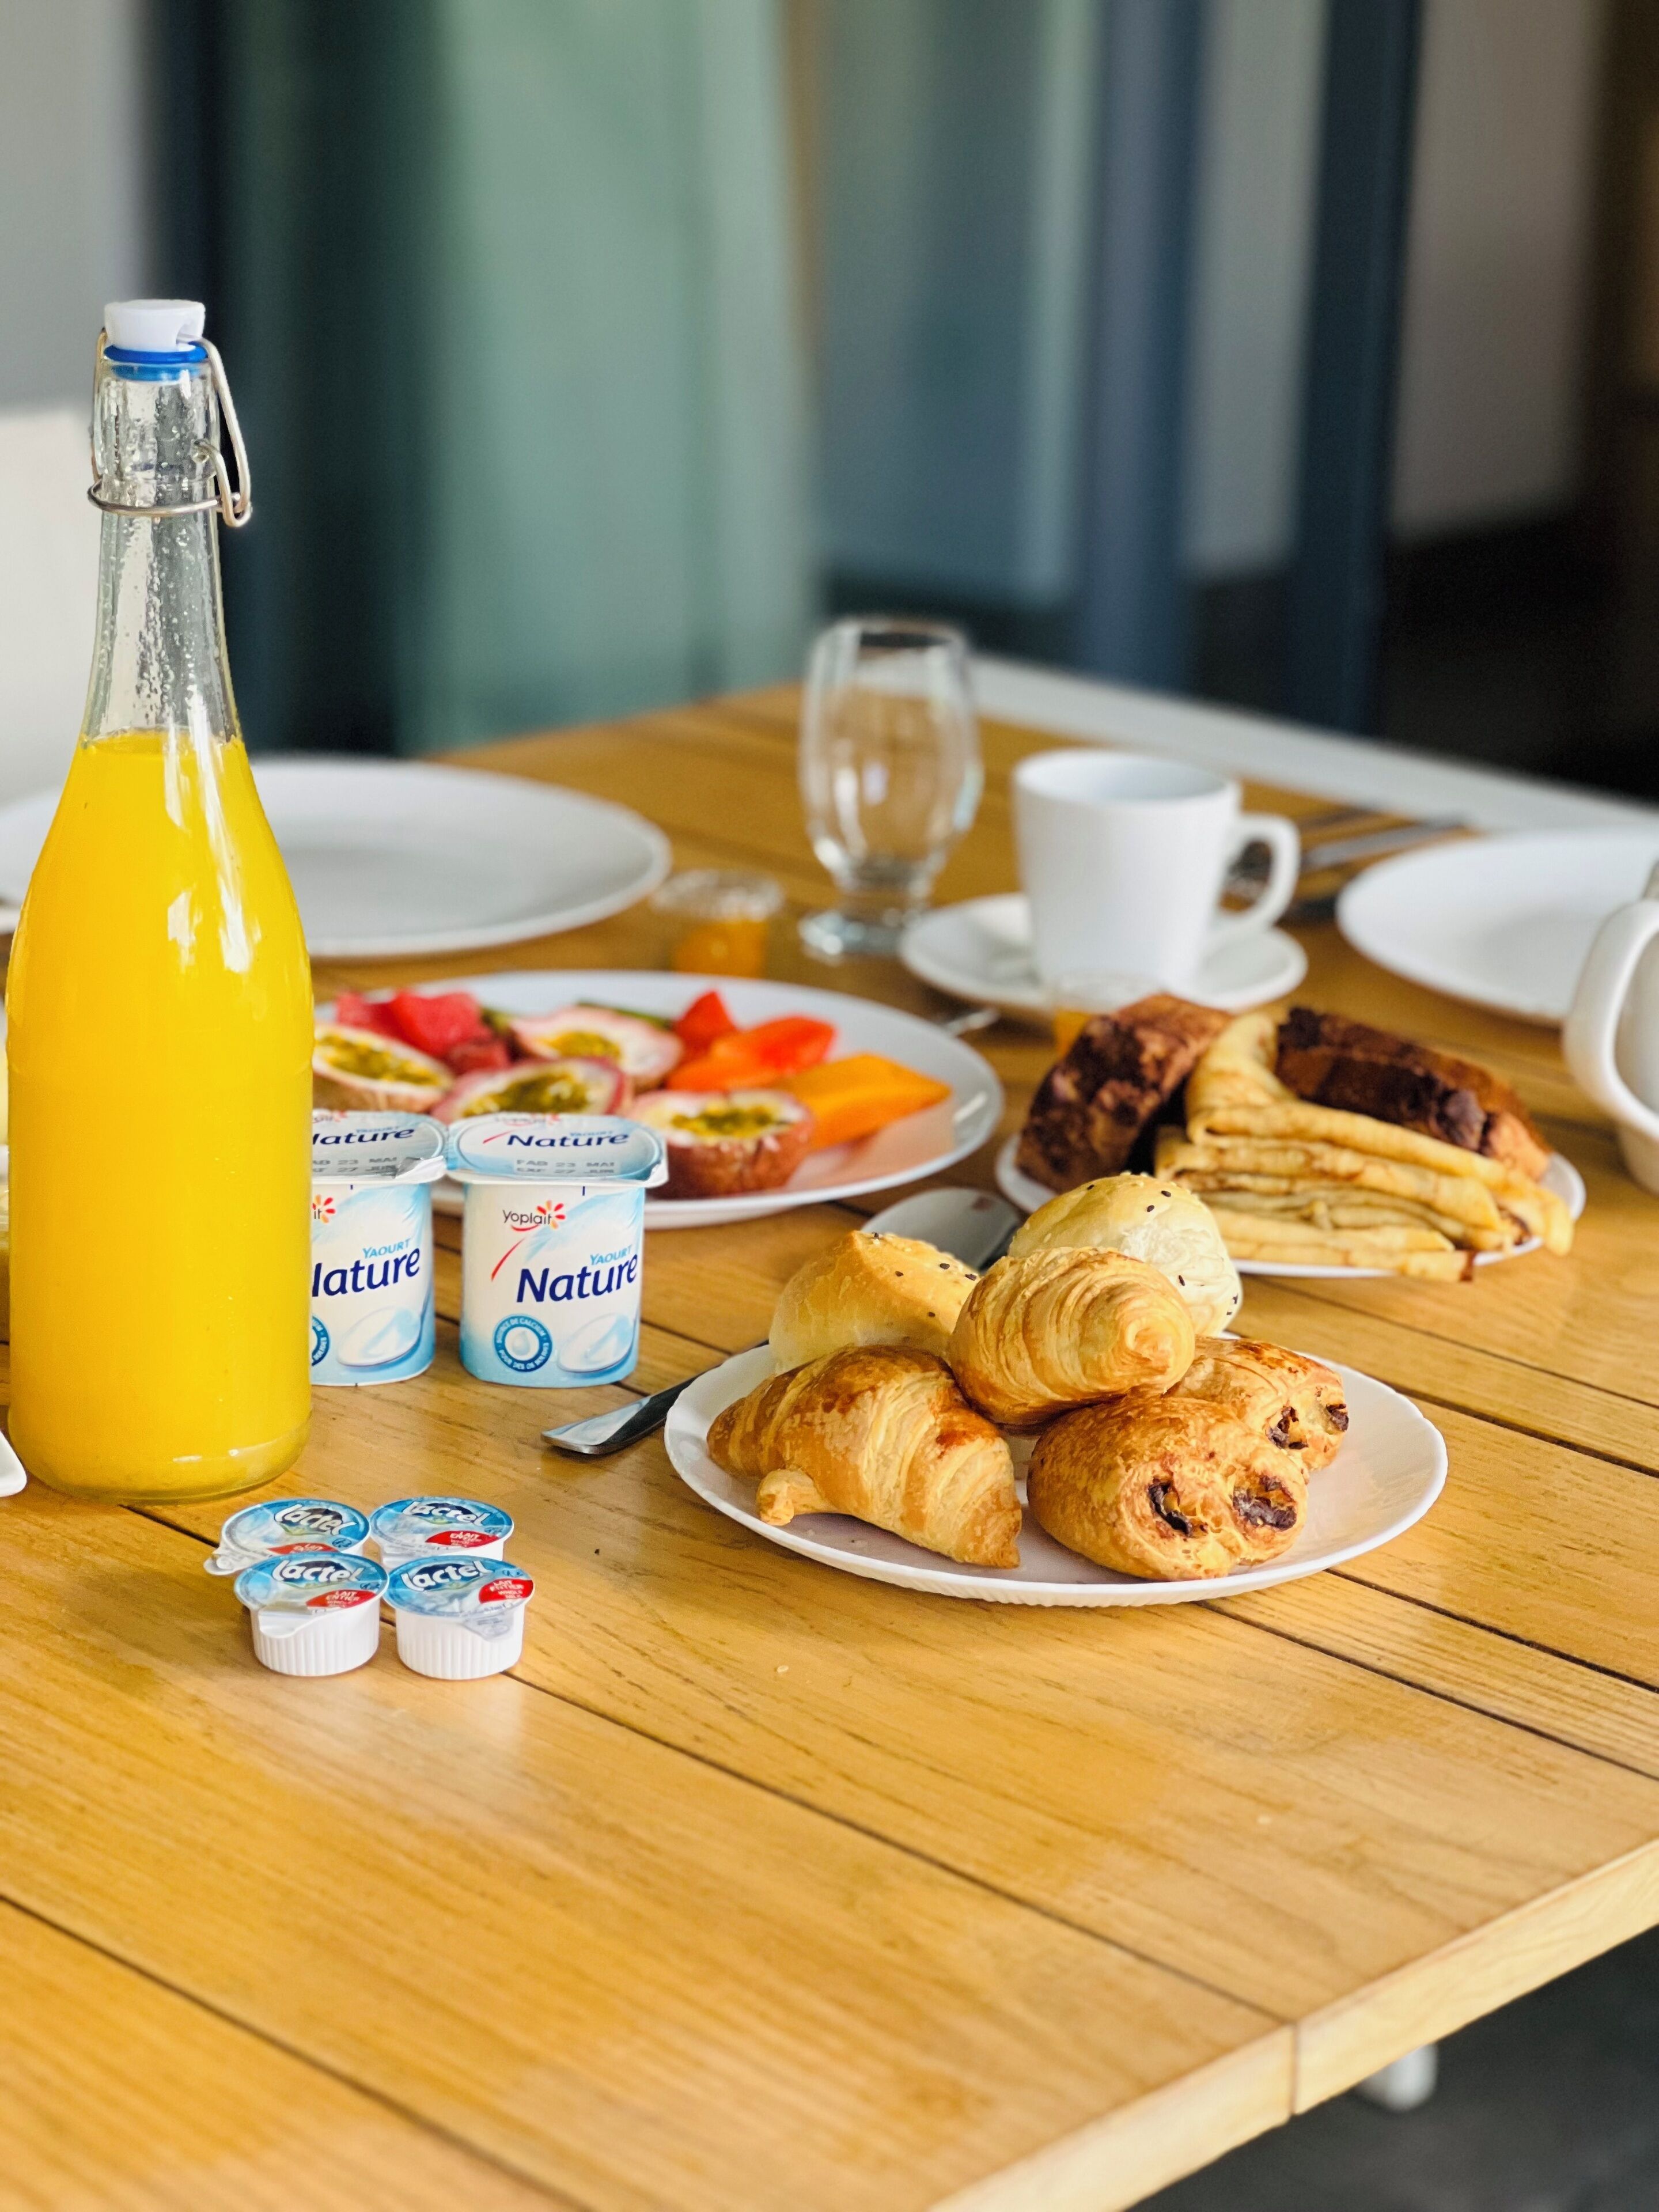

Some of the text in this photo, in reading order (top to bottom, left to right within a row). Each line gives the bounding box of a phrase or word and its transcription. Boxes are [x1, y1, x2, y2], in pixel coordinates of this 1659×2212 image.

[507, 1134, 630, 1147] Nature
[502, 1209, 552, 1225] Yoplait
[362, 1238, 411, 1259] YAOURT
[590, 1244, 632, 1266] YAOURT
[516, 1254, 638, 1302] Nature
[274, 1503, 357, 1536] lactel
[402, 1501, 491, 1527] lactel
[272, 1560, 365, 1582] lactel
[401, 1560, 494, 1592] lactel
